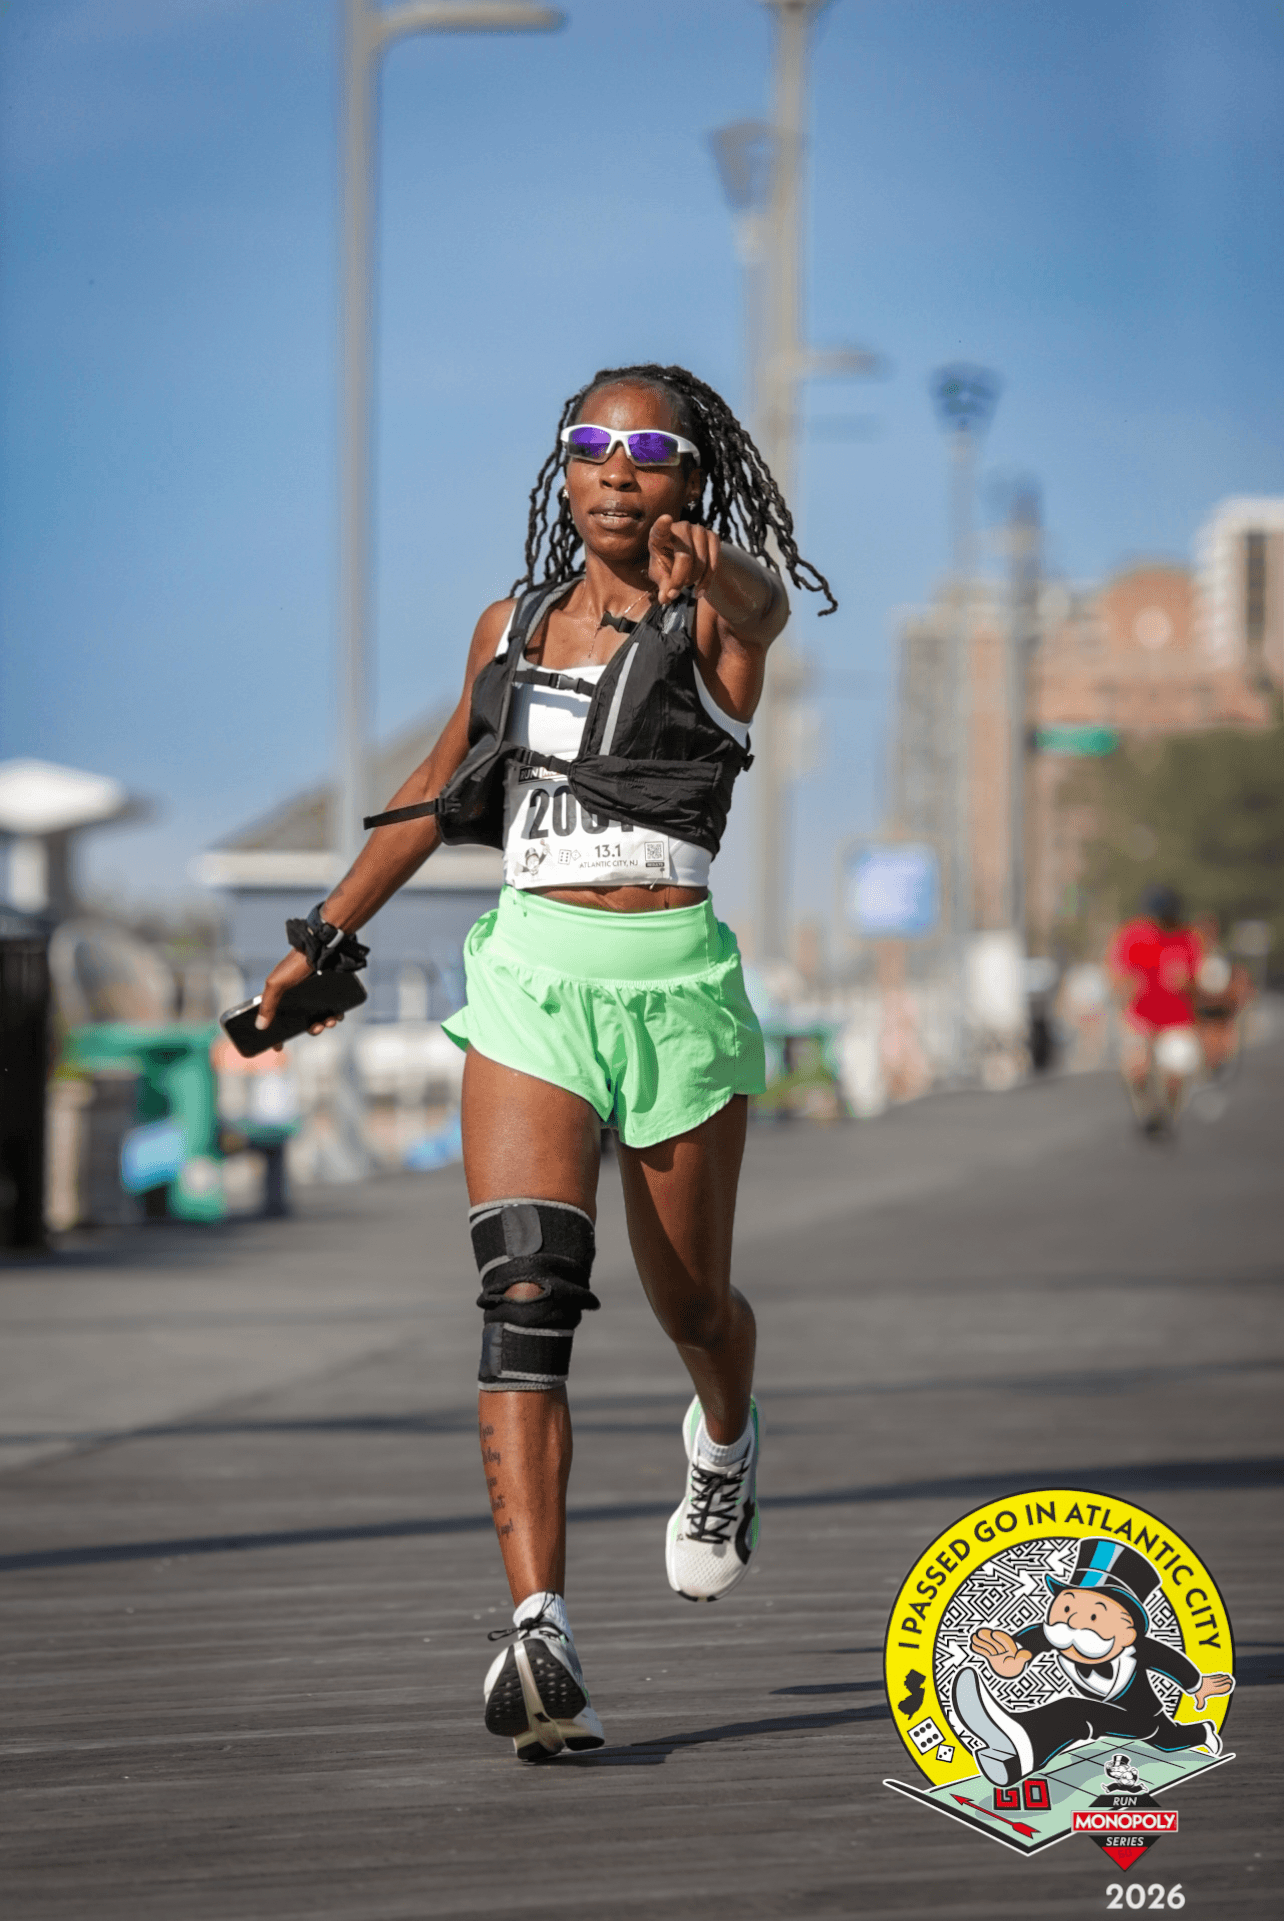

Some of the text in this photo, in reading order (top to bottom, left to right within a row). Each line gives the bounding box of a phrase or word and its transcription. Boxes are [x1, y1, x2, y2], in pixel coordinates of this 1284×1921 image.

[520, 767, 538, 780] RUN
[595, 844, 621, 858] 13.1
[579, 859, 639, 869] ATLANTIC CITY, NJ
